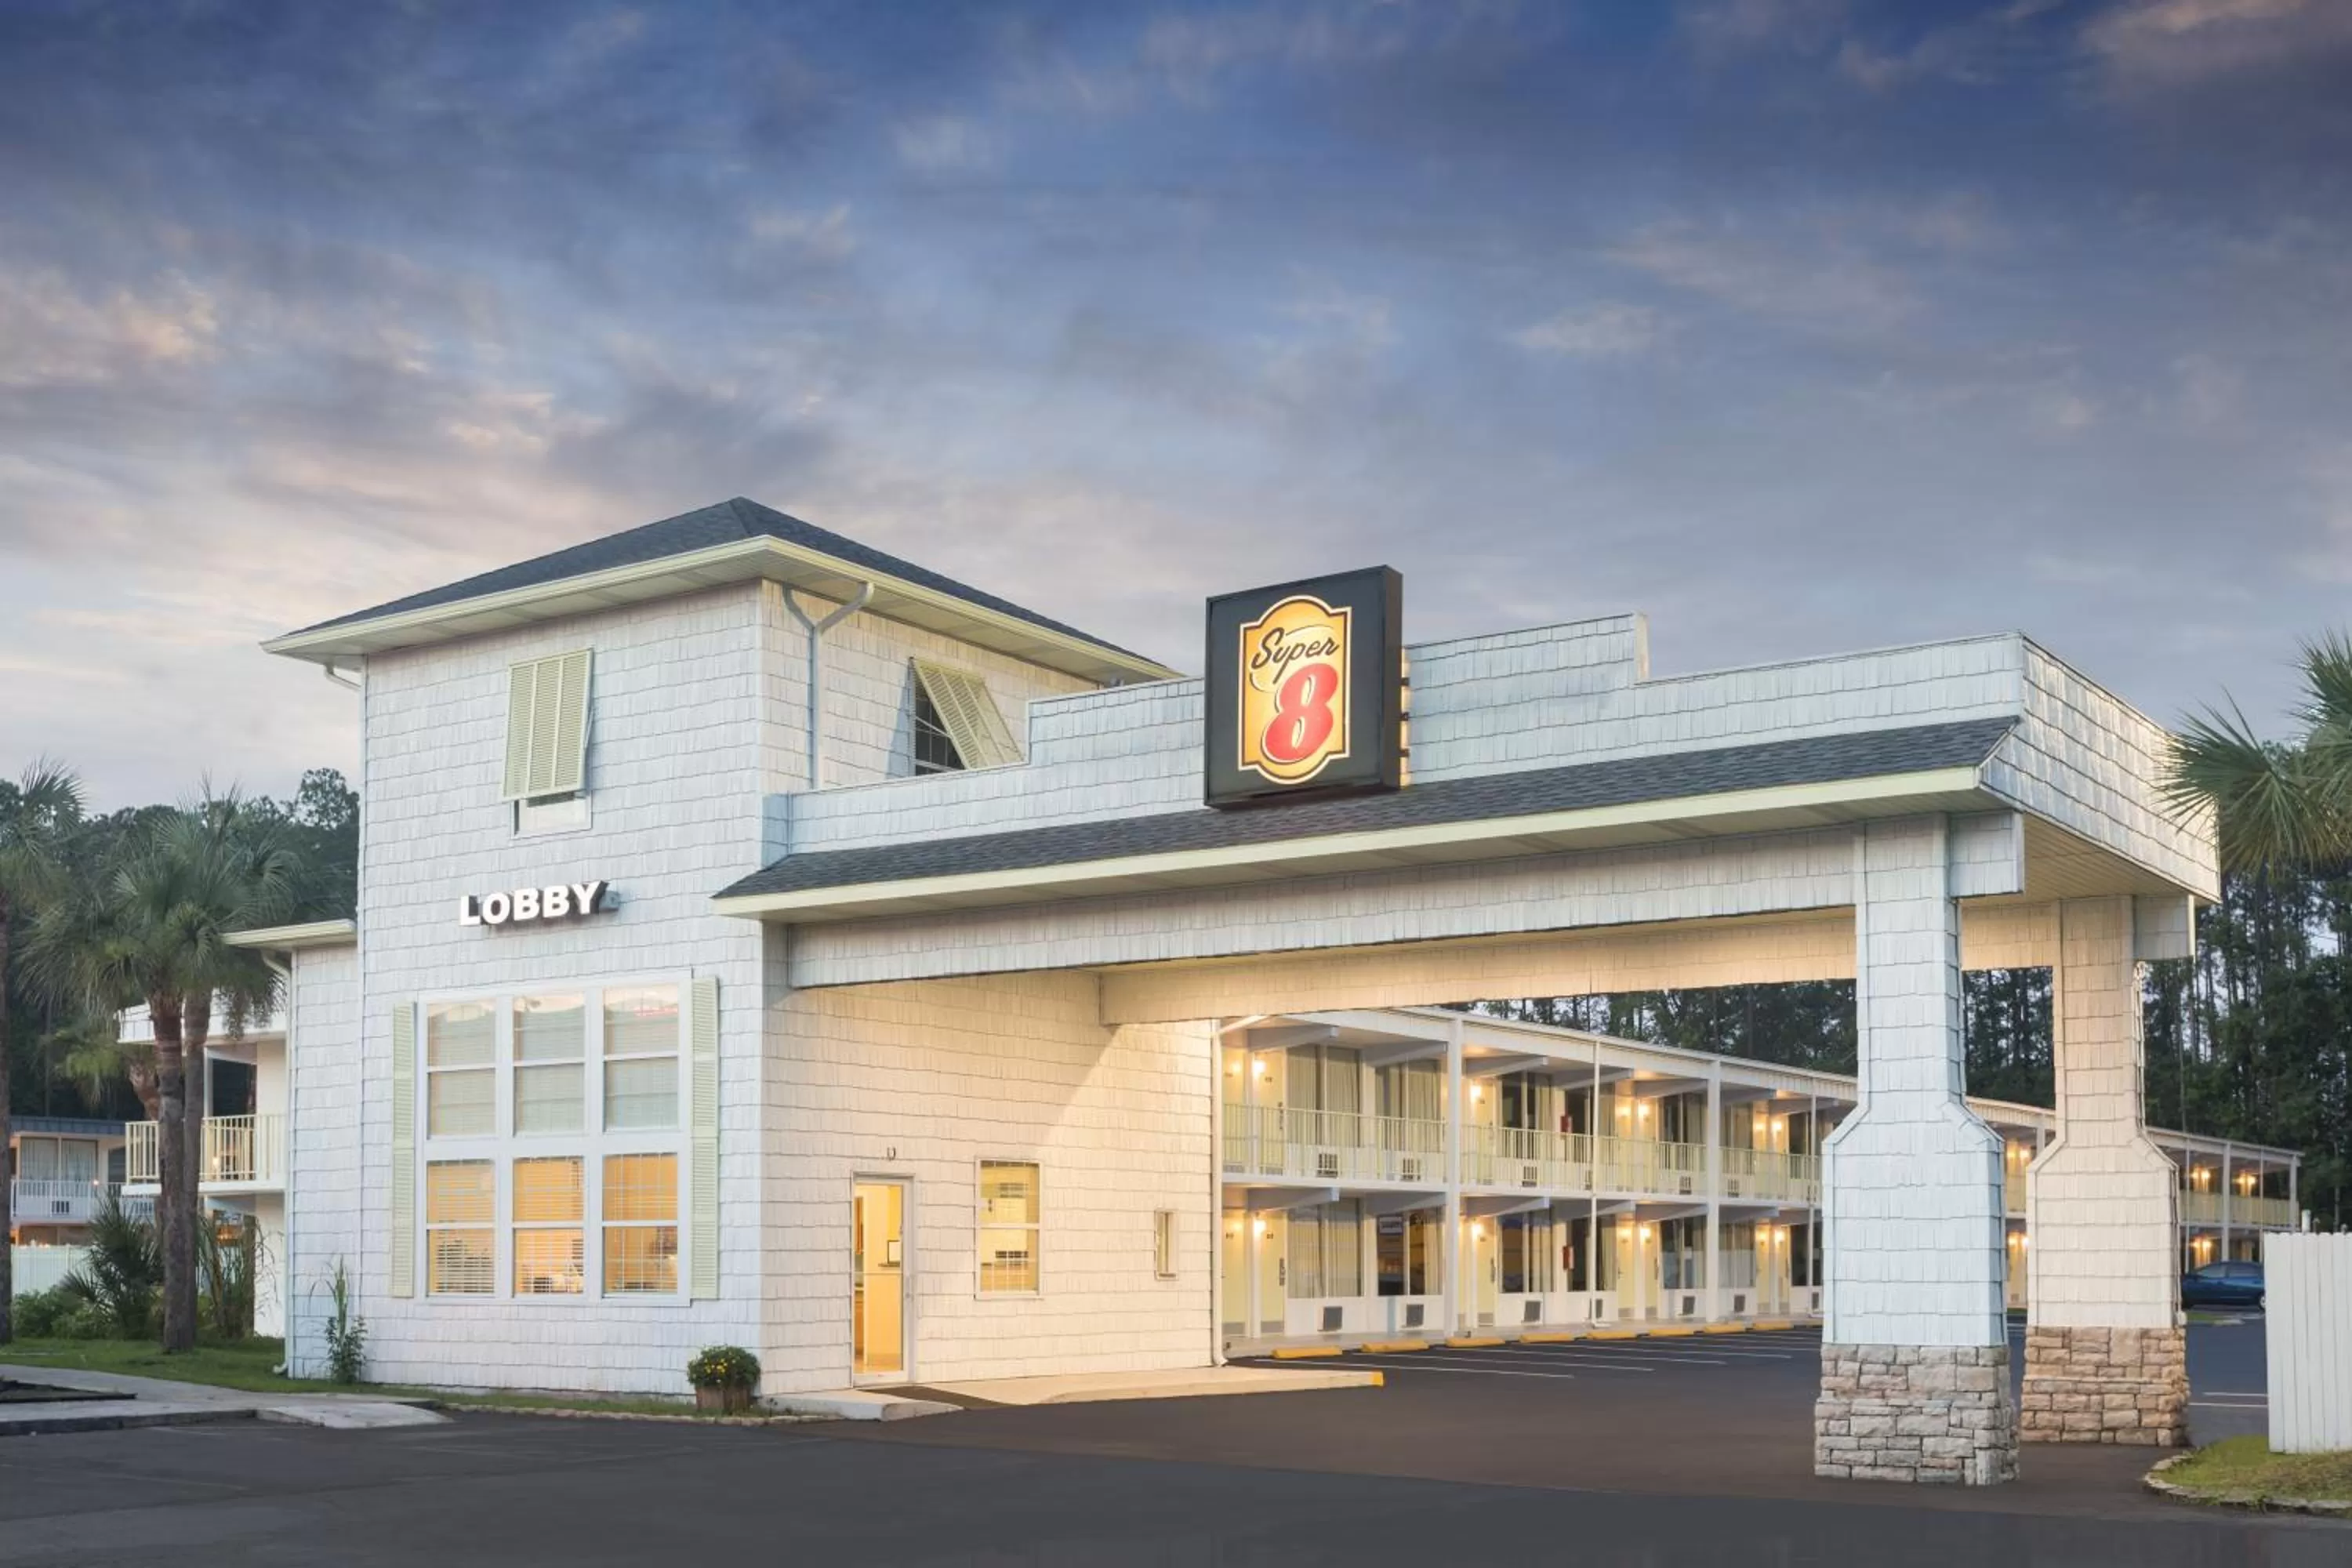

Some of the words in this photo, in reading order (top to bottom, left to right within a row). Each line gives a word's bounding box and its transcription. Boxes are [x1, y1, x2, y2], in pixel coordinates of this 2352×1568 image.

[1250, 626, 1340, 684] Super
[1262, 662, 1338, 763] 8
[459, 880, 604, 927] LOBBY
